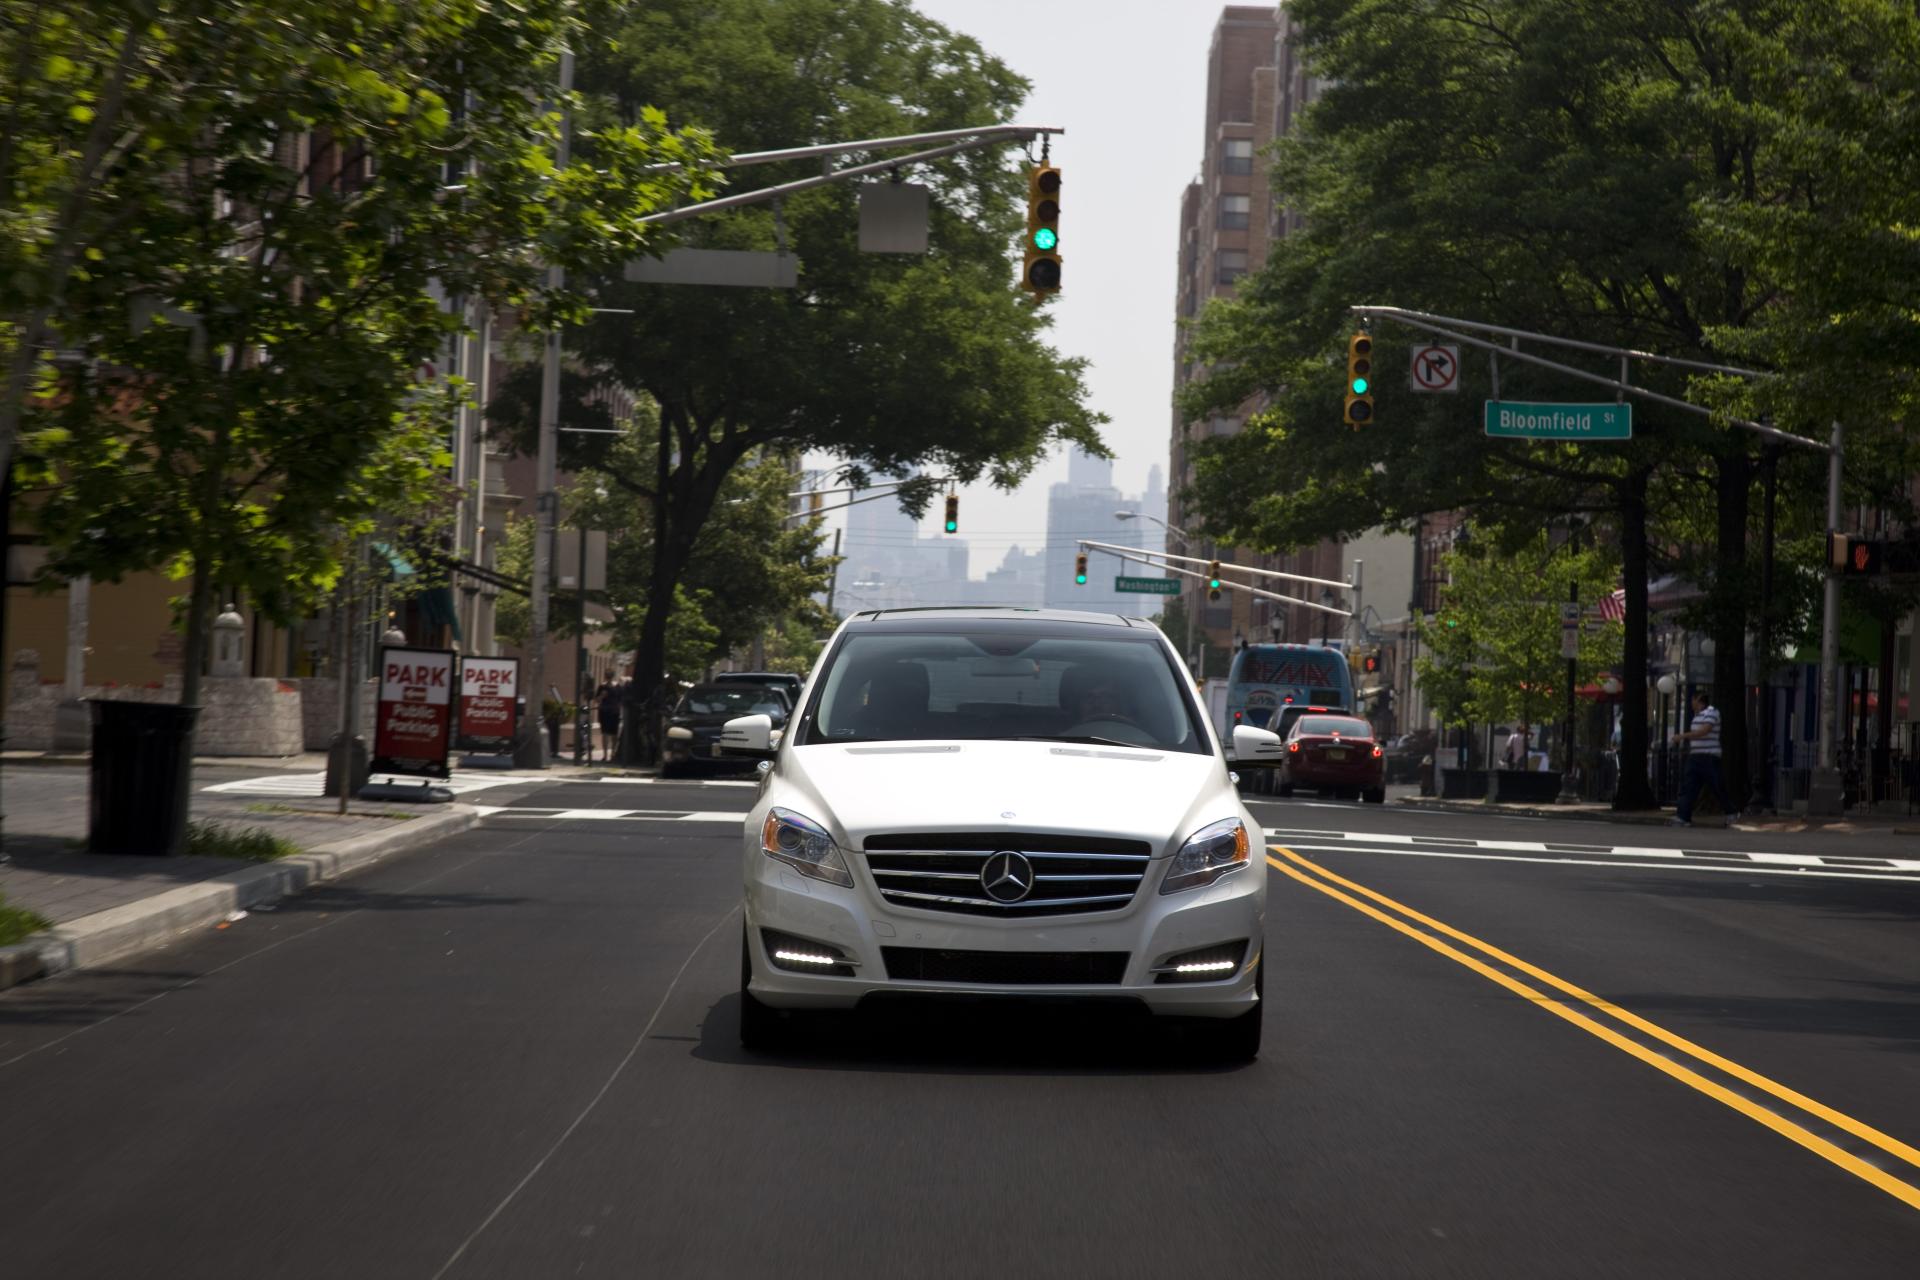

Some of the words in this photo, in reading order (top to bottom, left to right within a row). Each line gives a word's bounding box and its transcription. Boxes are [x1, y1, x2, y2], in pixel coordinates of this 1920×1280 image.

[1500, 409, 1591, 431] Bloomfield
[1603, 412, 1615, 424] St
[1119, 580, 1170, 591] Washington
[386, 664, 447, 687] PARK
[465, 668, 512, 684] PARK
[1245, 660, 1332, 687] RE/MAX
[470, 697, 505, 708] Public
[392, 703, 437, 719] Public
[466, 707, 508, 721] Parking
[386, 718, 440, 738] Parking
